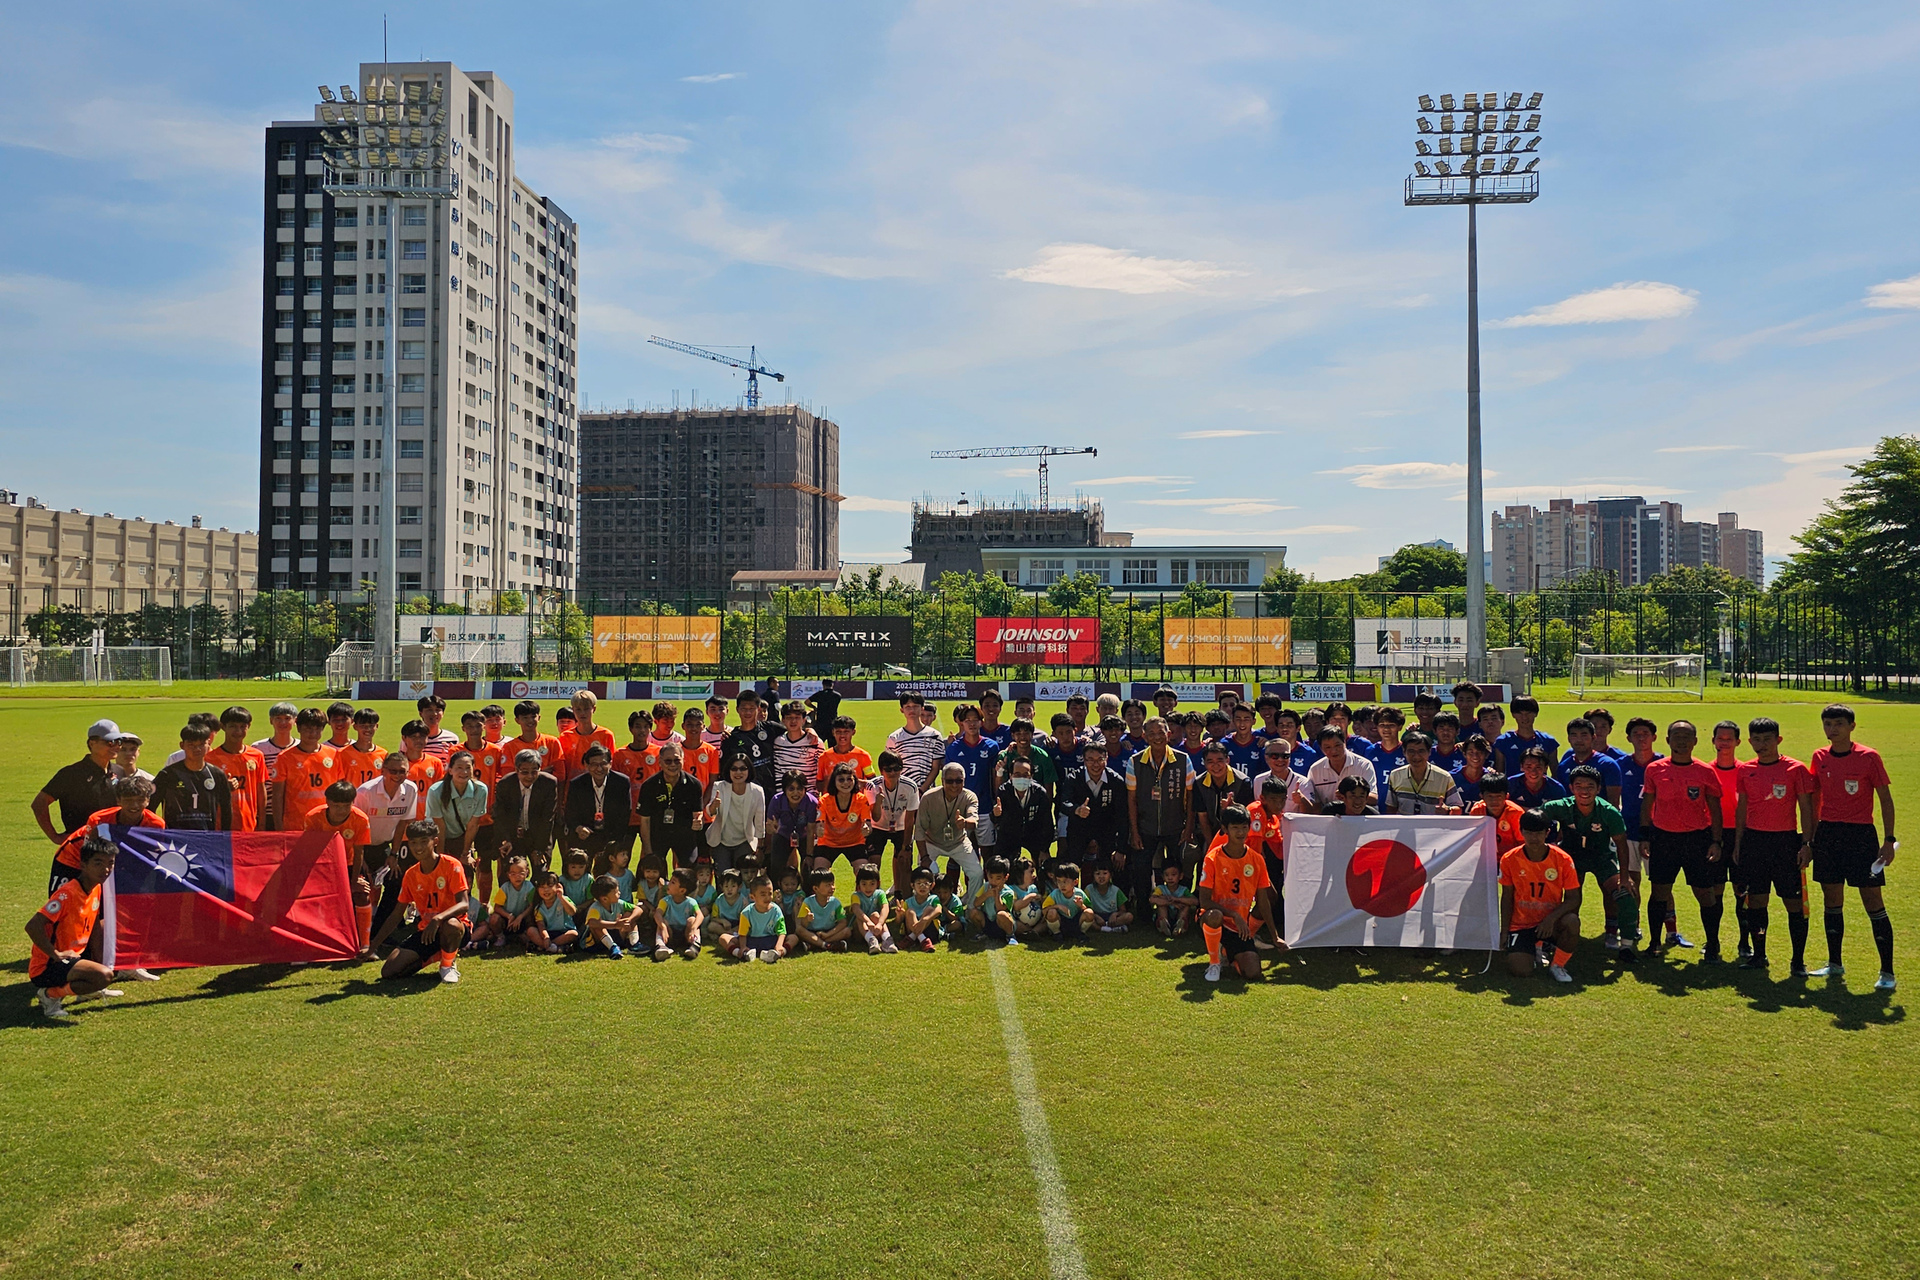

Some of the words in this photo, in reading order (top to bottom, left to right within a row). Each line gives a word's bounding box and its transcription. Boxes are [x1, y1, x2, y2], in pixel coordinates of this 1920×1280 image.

[614, 633, 660, 641] SCHOOLS
[662, 633, 699, 641] TAIWAN
[808, 632, 890, 641] MATRIX
[993, 629, 1079, 643] JOHNSON
[1186, 635, 1230, 643] SCHOOLS
[1232, 635, 1269, 643] TAIWAN
[752, 745, 761, 757] 8
[970, 763, 976, 776] 3
[309, 773, 323, 787] 16
[192, 794, 199, 809] 1
[1231, 878, 1241, 894] 3
[1529, 882, 1545, 898] 17
